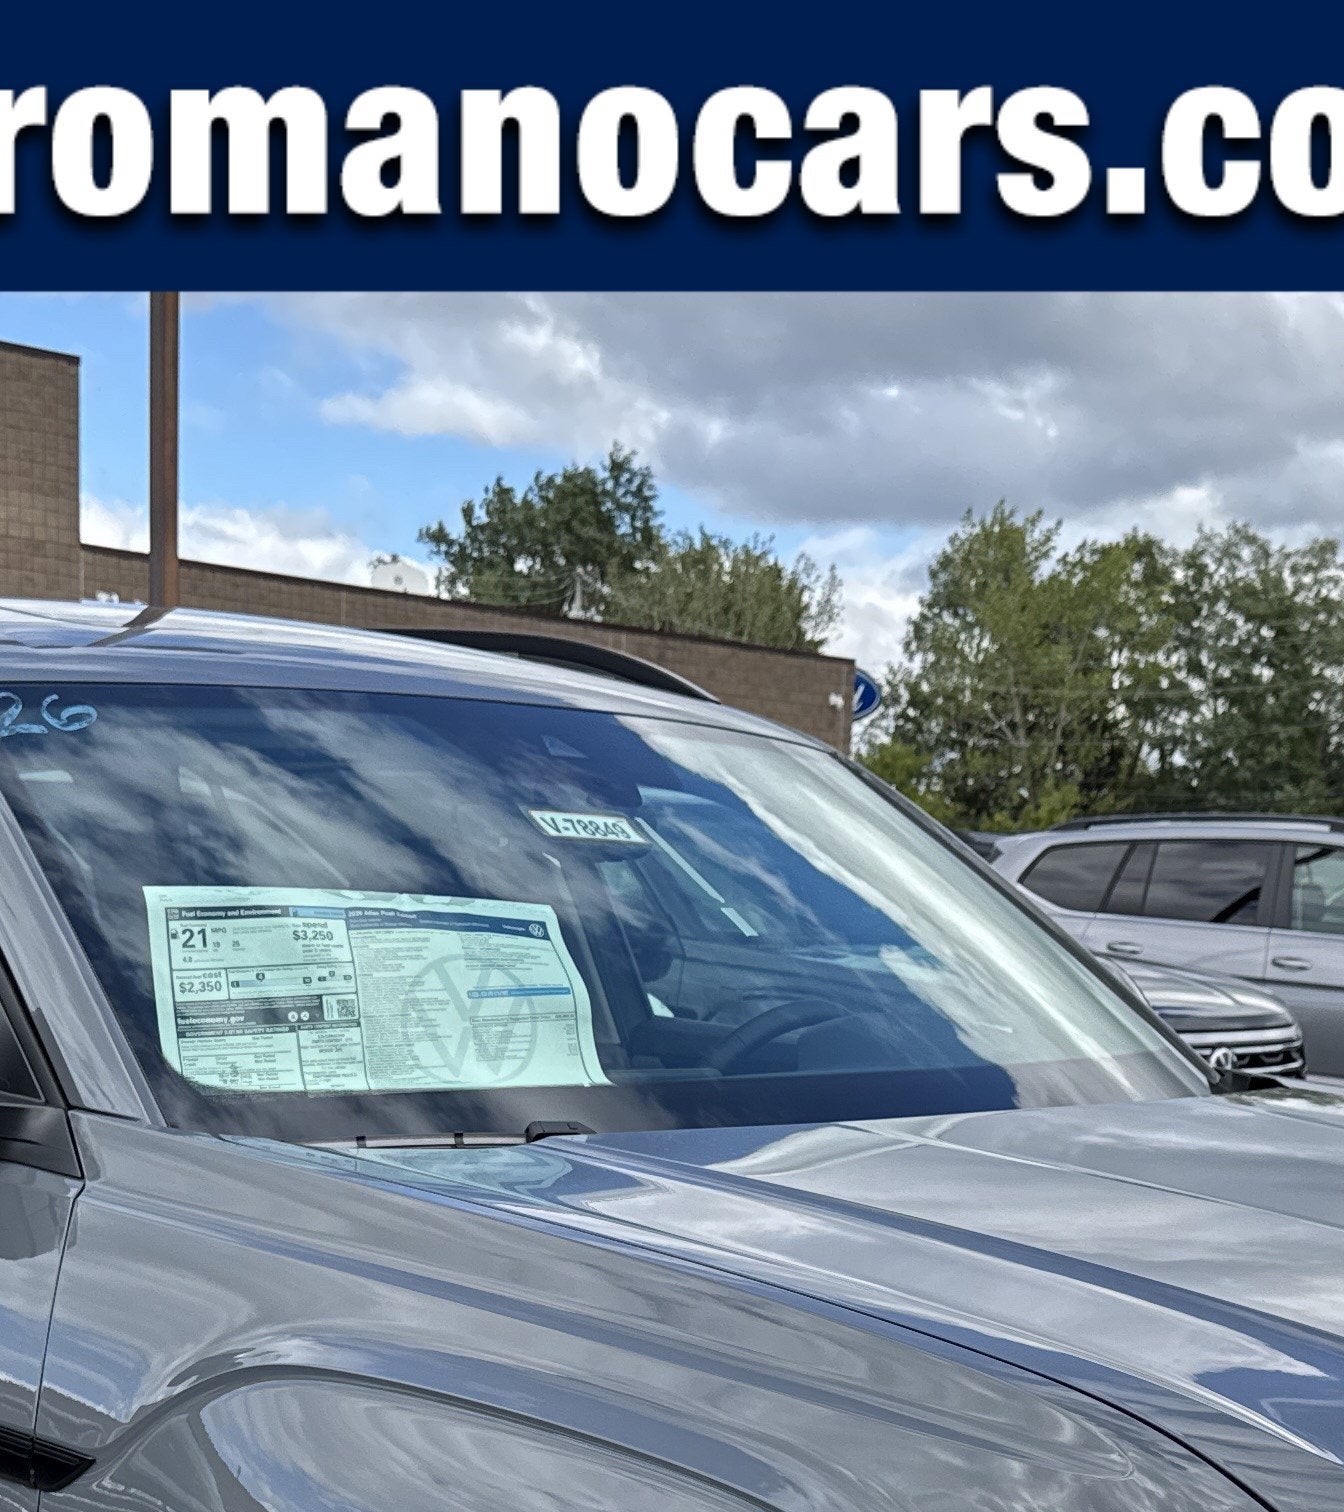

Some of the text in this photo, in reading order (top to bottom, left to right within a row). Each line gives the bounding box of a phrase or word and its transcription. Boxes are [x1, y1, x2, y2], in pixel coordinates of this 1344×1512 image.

[181, 928, 207, 948] 21
[292, 930, 334, 941] $3,250
[179, 981, 222, 994] $2,350
